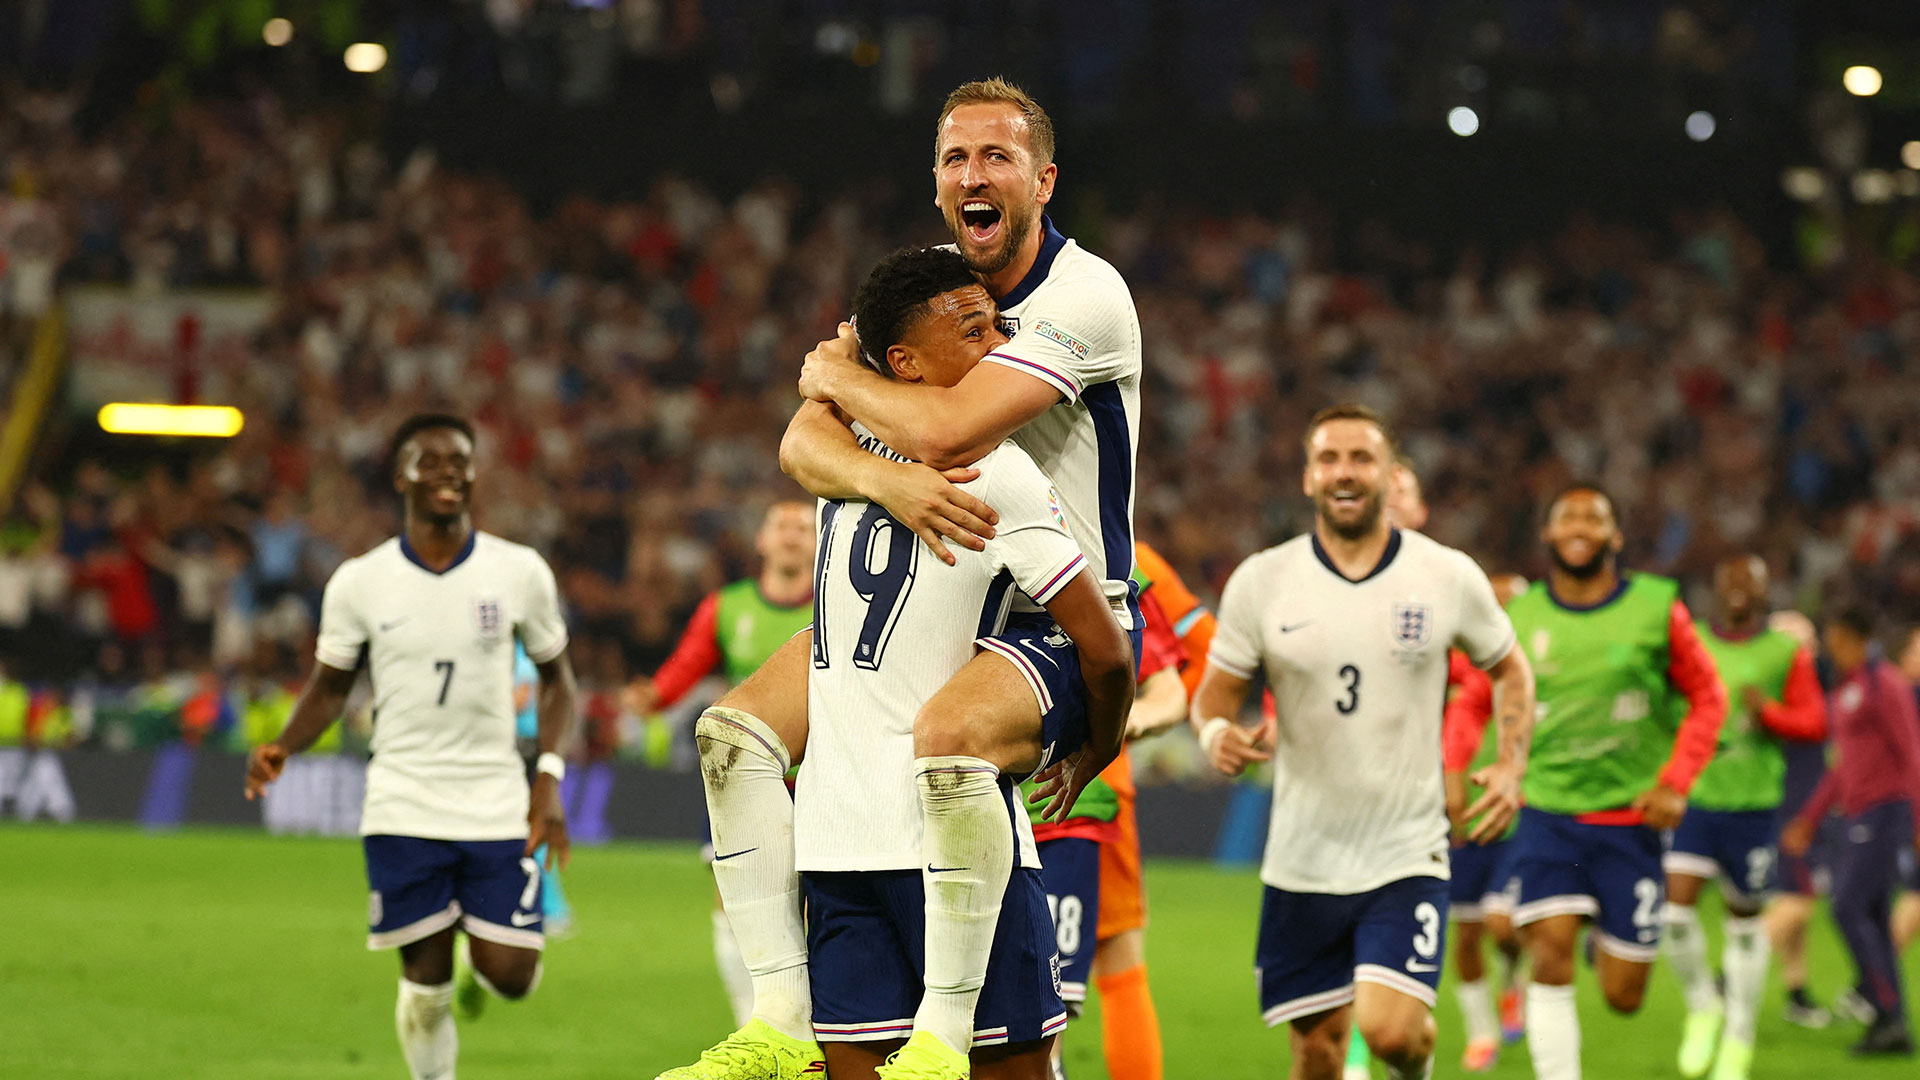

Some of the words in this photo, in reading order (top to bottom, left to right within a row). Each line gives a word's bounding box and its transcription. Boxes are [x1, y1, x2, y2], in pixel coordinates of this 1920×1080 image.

[1035, 324, 1090, 356] FOUNDATION
[813, 499, 920, 671] 19
[434, 660, 456, 707] 7
[1335, 664, 1361, 715] 3
[519, 857, 540, 911] 7
[1412, 901, 1440, 959] 3
